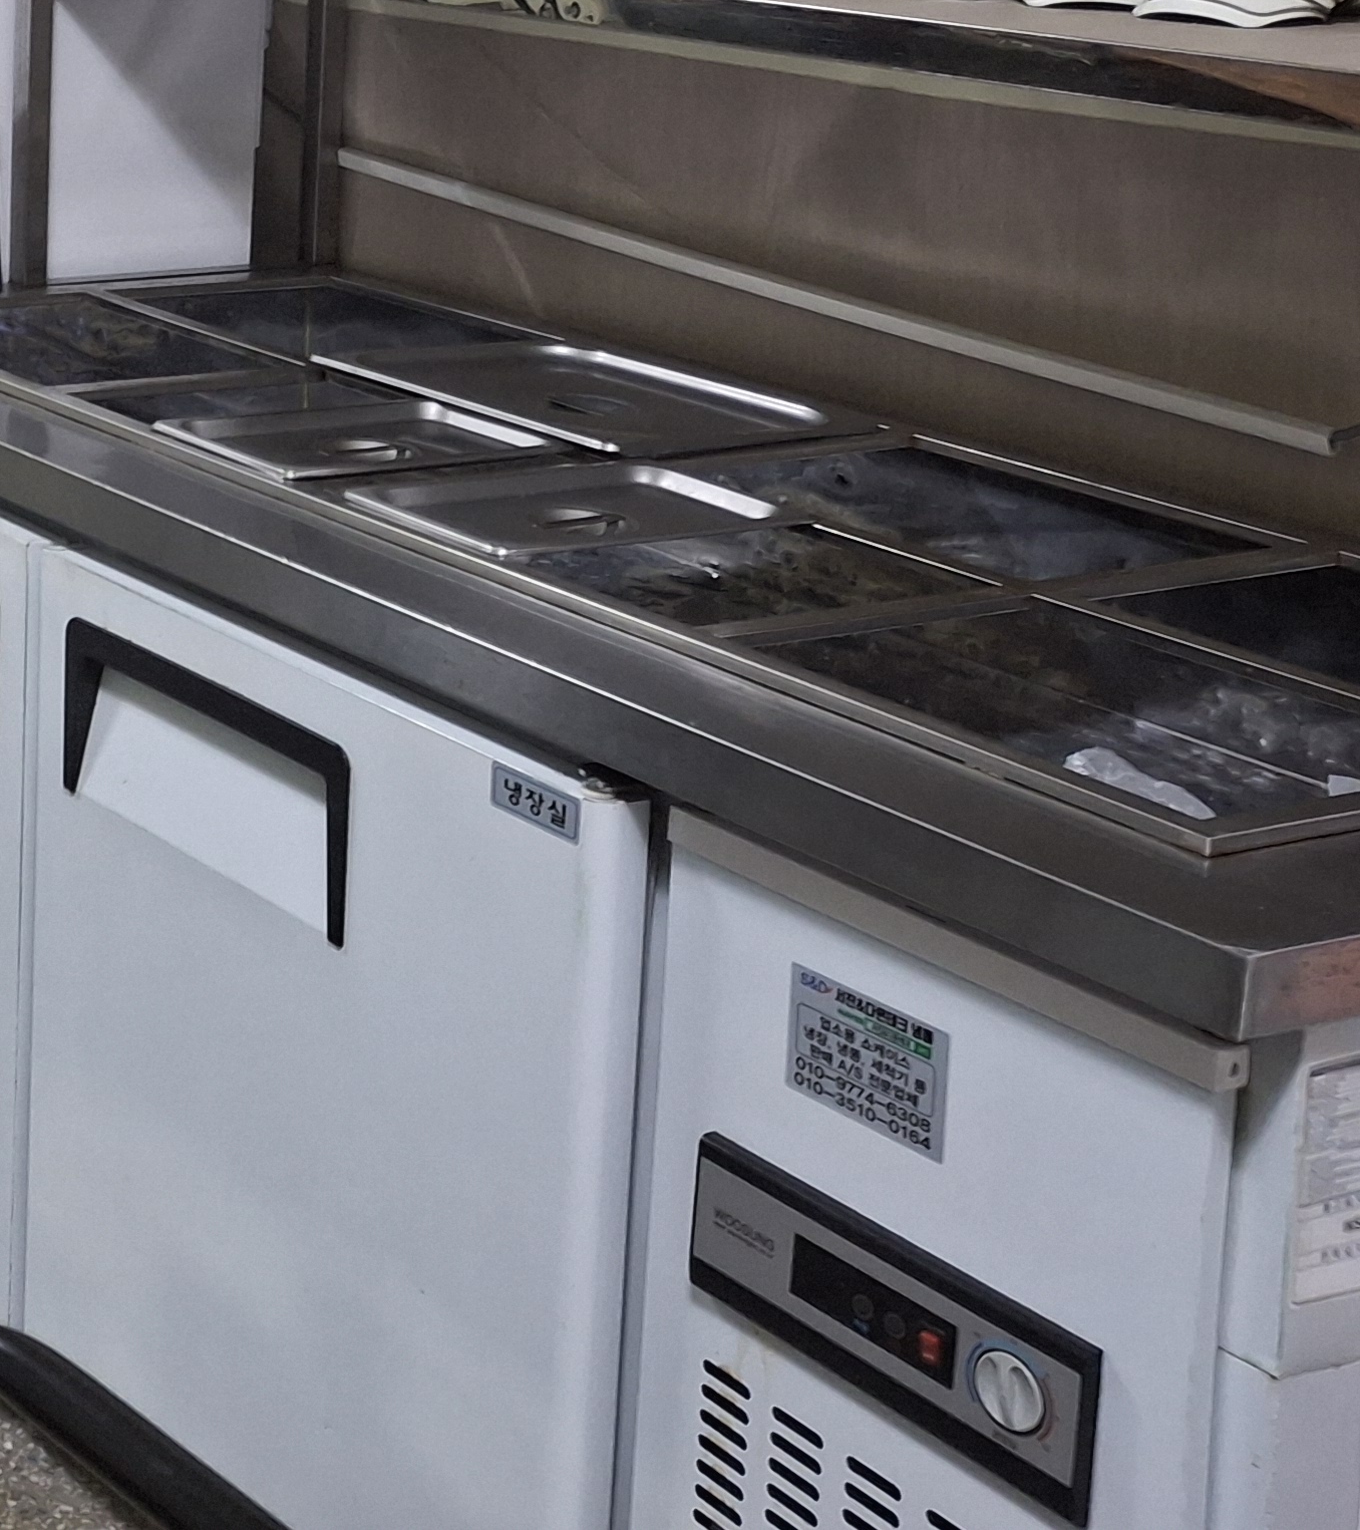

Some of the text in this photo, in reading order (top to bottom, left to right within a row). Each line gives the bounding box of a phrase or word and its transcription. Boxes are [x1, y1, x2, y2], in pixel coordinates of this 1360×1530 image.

[504, 778, 567, 829] 냉장실
[837, 1060, 863, 1080] A/S
[793, 1071, 931, 1151] 010-3510-0164
